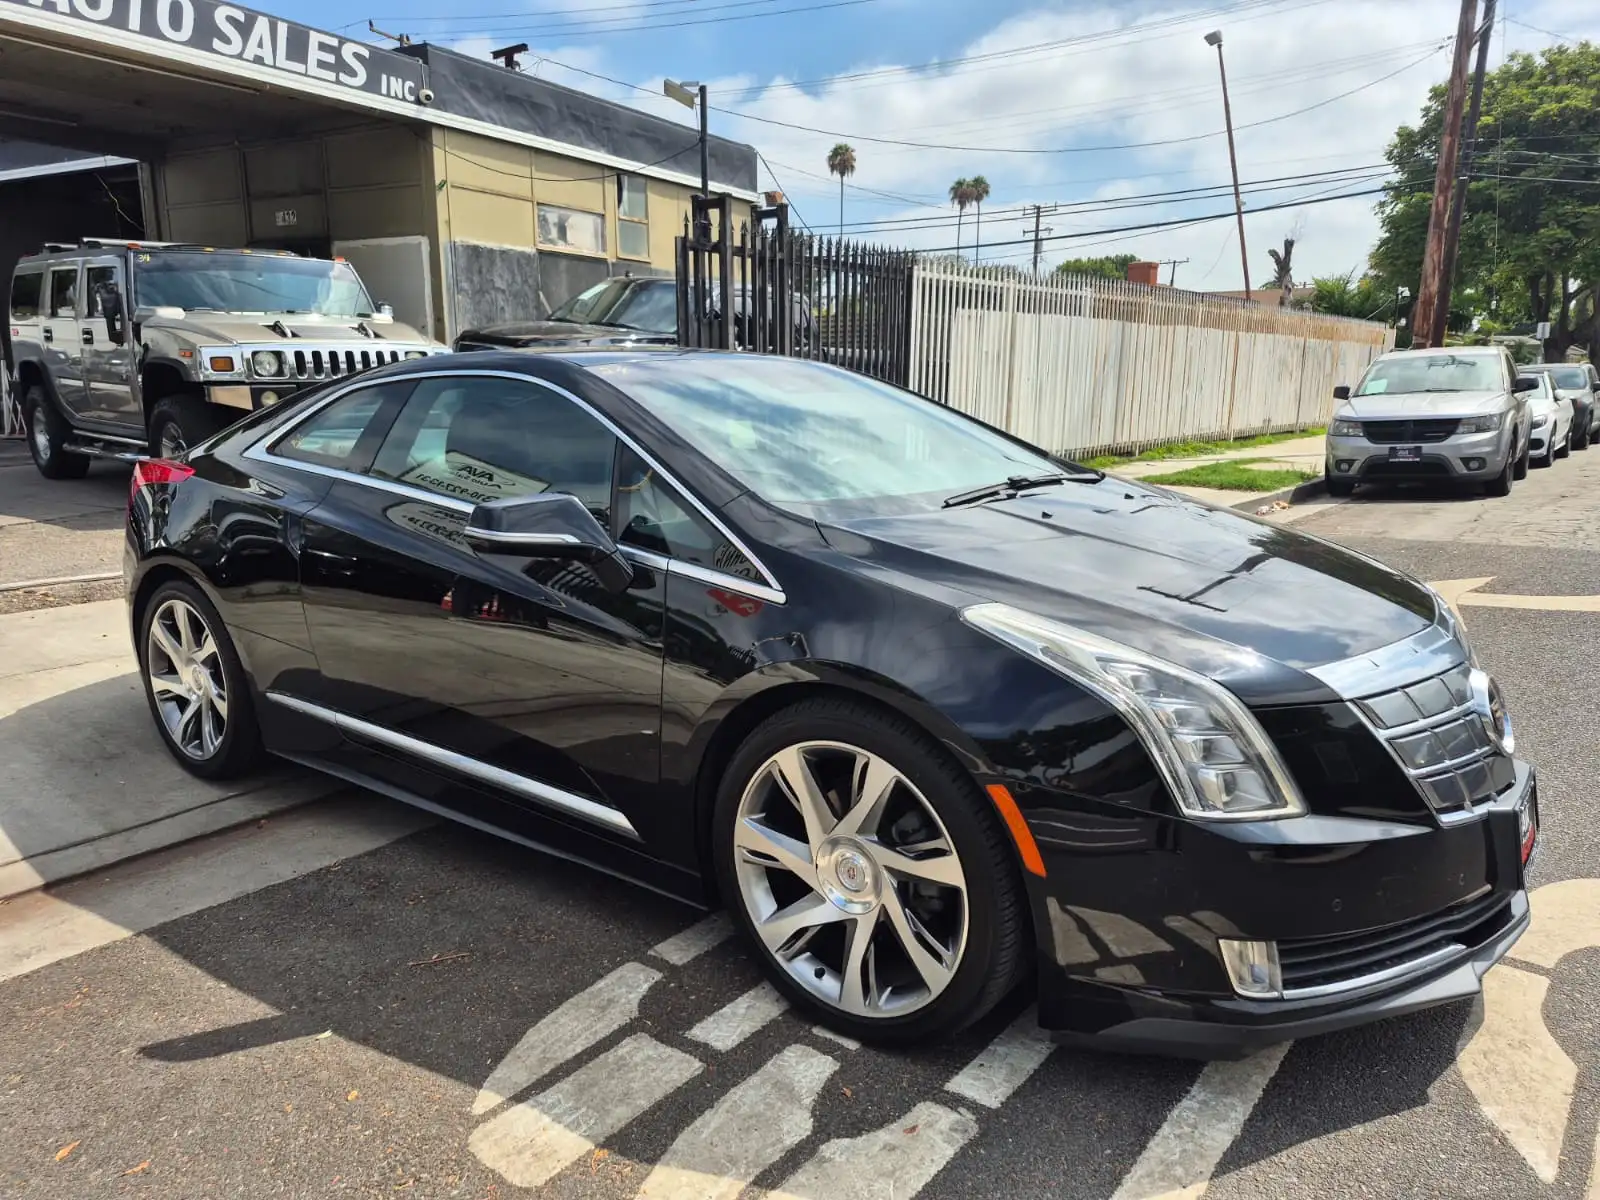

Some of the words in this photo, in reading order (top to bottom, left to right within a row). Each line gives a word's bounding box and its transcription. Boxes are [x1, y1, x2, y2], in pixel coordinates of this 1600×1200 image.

[27, 0, 196, 42] TO
[212, 4, 370, 88] SALES
[381, 73, 416, 101] INC
